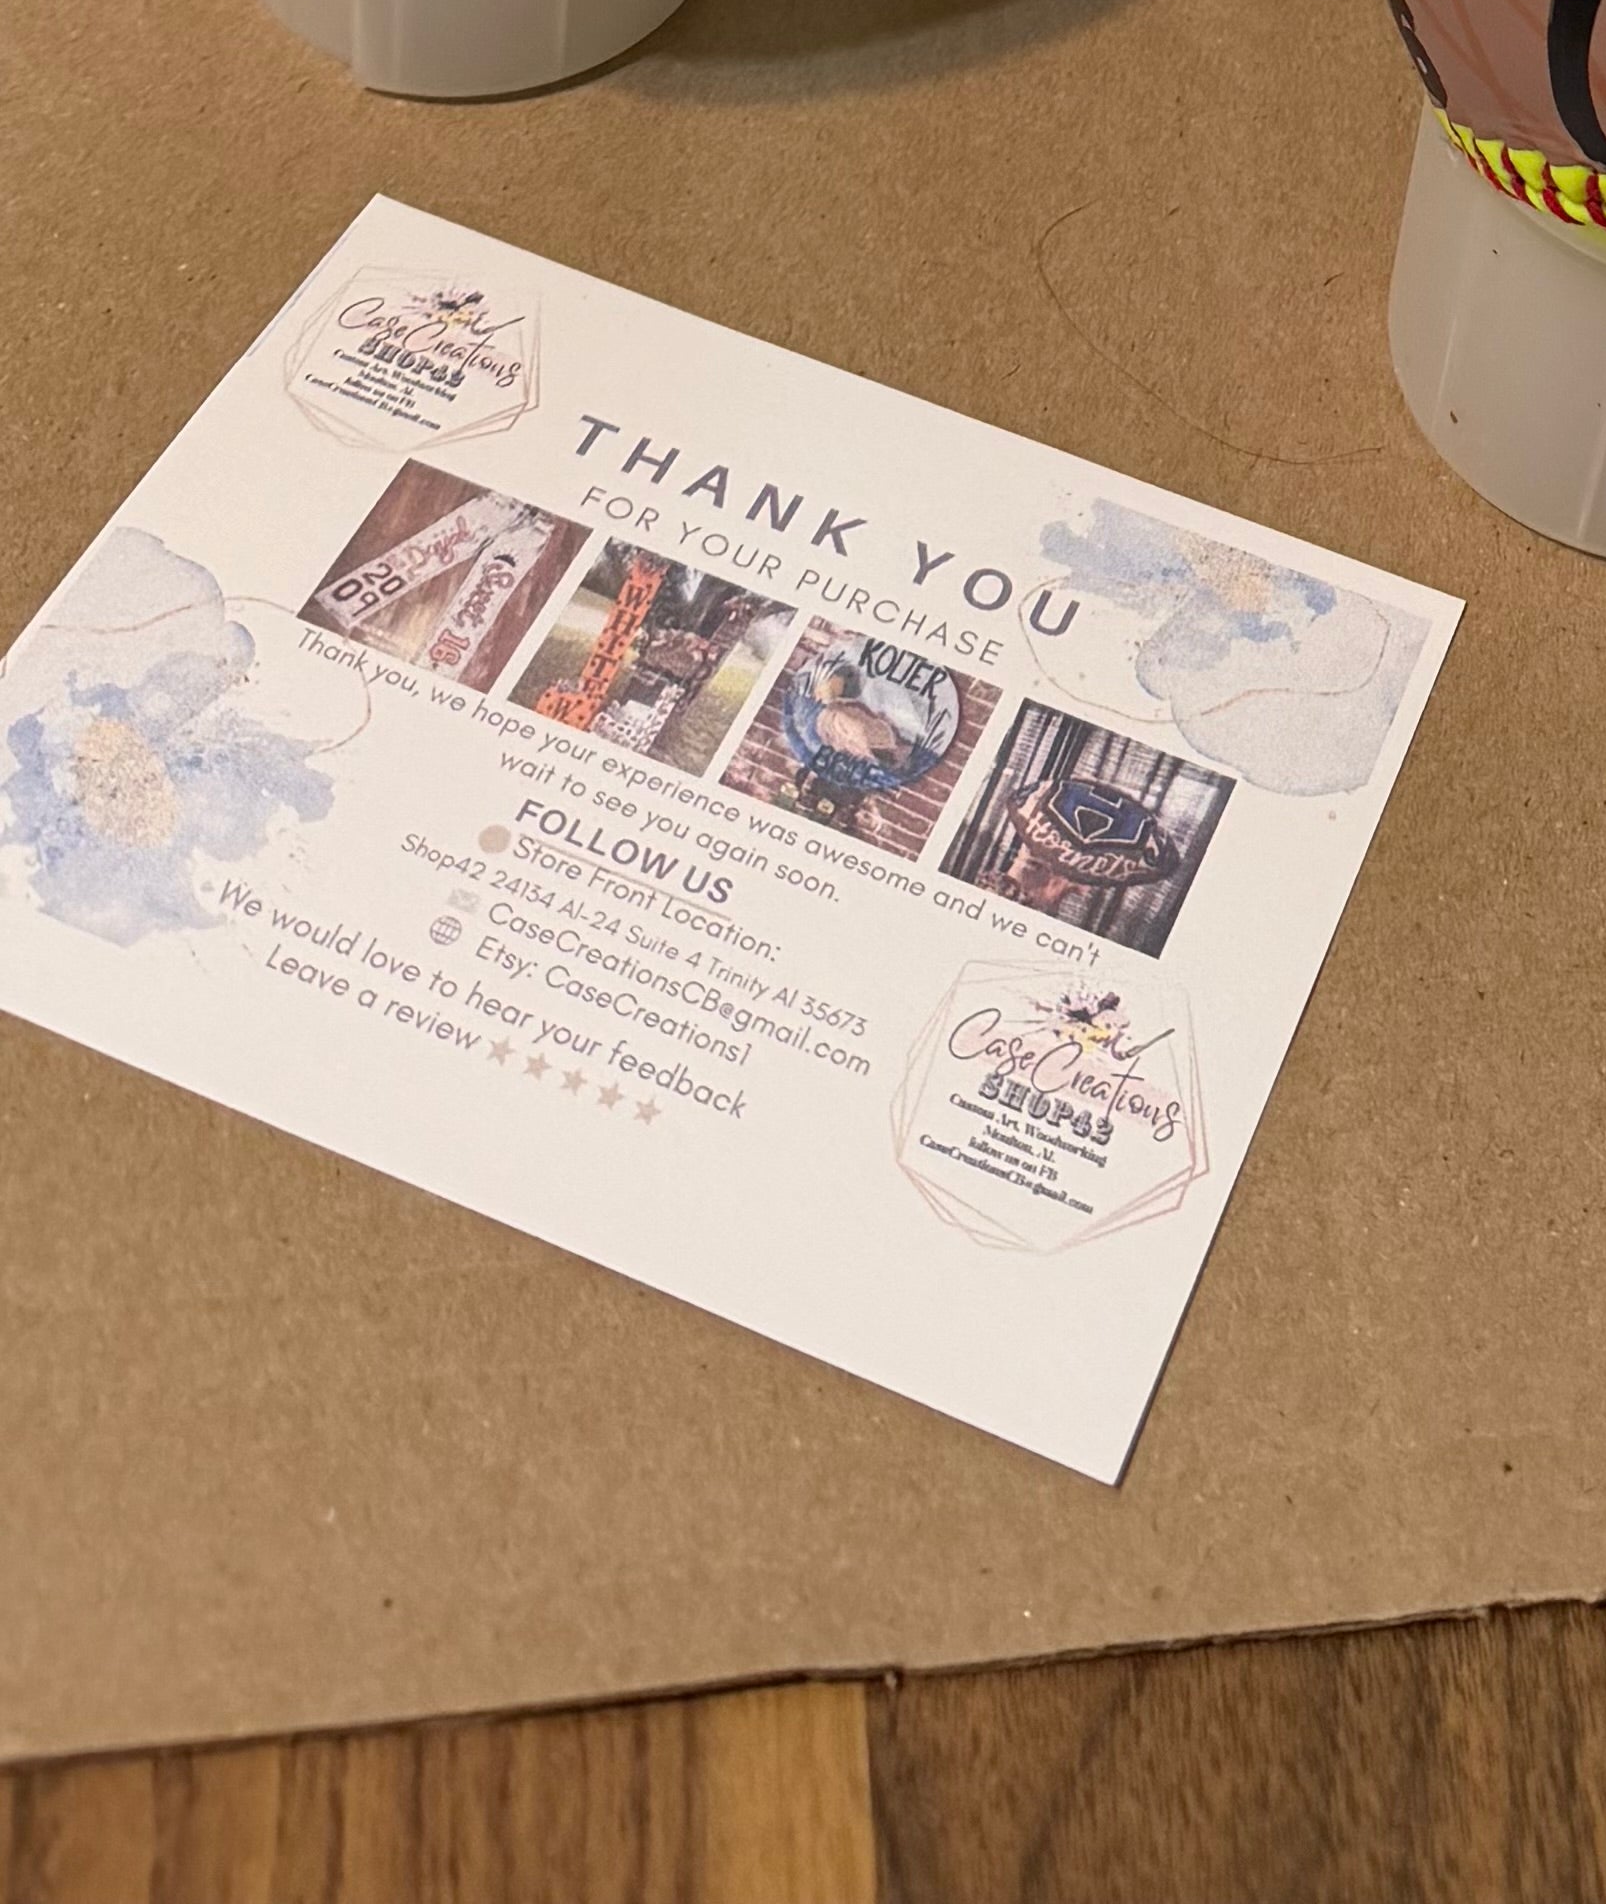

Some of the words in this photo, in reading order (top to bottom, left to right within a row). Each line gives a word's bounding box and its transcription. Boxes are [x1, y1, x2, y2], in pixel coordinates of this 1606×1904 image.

[574, 413, 868, 558] THANK
[912, 539, 1081, 638] YOU
[579, 485, 661, 534] FOR
[678, 520, 783, 580] YOUR
[795, 568, 1006, 667] PURCHASE
[858, 638, 948, 701] KOLTER
[298, 627, 365, 672] Thank
[372, 663, 420, 697] you,
[430, 685, 466, 712] we
[471, 698, 536, 740] hope
[538, 731, 598, 766] your
[601, 757, 740, 823] experience
[748, 817, 798, 847] was
[804, 840, 927, 898] awesome
[933, 893, 988, 921] and
[991, 911, 1029, 939] we
[1035, 931, 1102, 968] can't
[500, 752, 556, 789] wait
[564, 773, 587, 798] to
[592, 791, 638, 818] see
[640, 810, 691, 840] you
[694, 831, 769, 872] again
[774, 864, 840, 903] soon.
[515, 798, 680, 880] FOLLOW
[682, 865, 735, 904] US
[400, 832, 488, 881] Shop42
[625, 924, 680, 960] Suite
[684, 950, 703, 969] 4
[707, 956, 770, 1002] Trinity
[800, 995, 869, 1037] 35673
[512, 835, 583, 881] Store
[588, 867, 660, 911] Front
[660, 894, 782, 963] Location:
[217, 879, 263, 918] We
[271, 908, 363, 957] would
[360, 937, 422, 983] love
[428, 969, 459, 998] to
[464, 980, 535, 1029] hear
[531, 1019, 603, 1058] your
[607, 1040, 748, 1120] feedback
[265, 943, 351, 996] Leave
[357, 988, 379, 1010] a
[383, 997, 483, 1052] review
[475, 935, 540, 980] Etsy:
[545, 965, 753, 1067] CaseCreations1
[488, 902, 871, 1077] CaseCreationsCB@gmail.com
